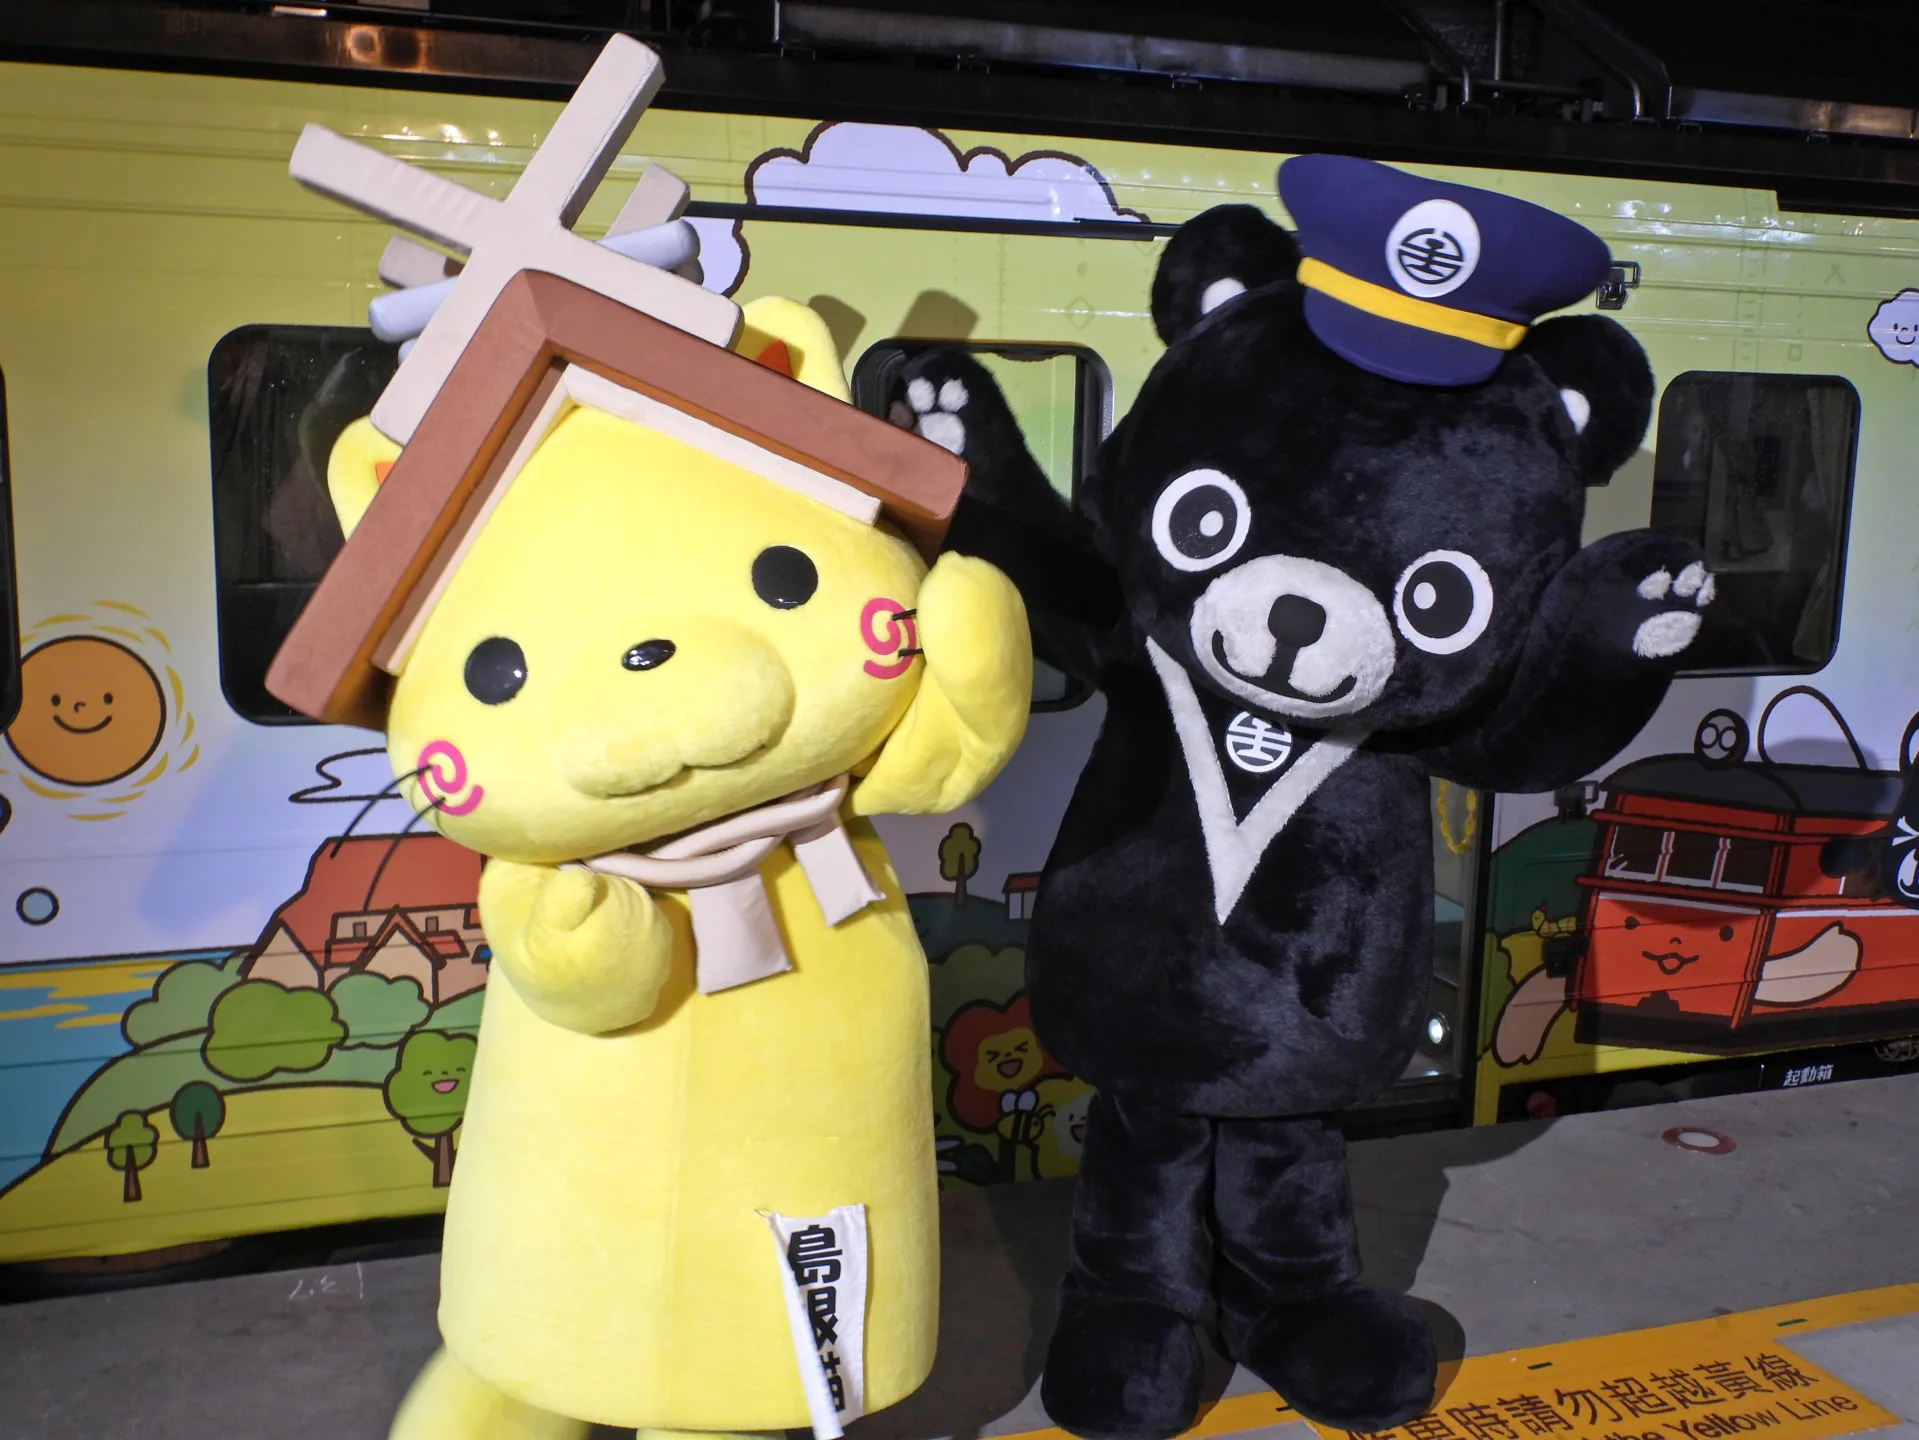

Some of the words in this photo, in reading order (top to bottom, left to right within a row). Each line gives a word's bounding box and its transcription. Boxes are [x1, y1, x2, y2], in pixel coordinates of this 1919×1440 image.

[1783, 1064, 1834, 1086] 起動箱
[1662, 1409, 1781, 1440] Yellow
[1776, 1395, 1858, 1421] Line
